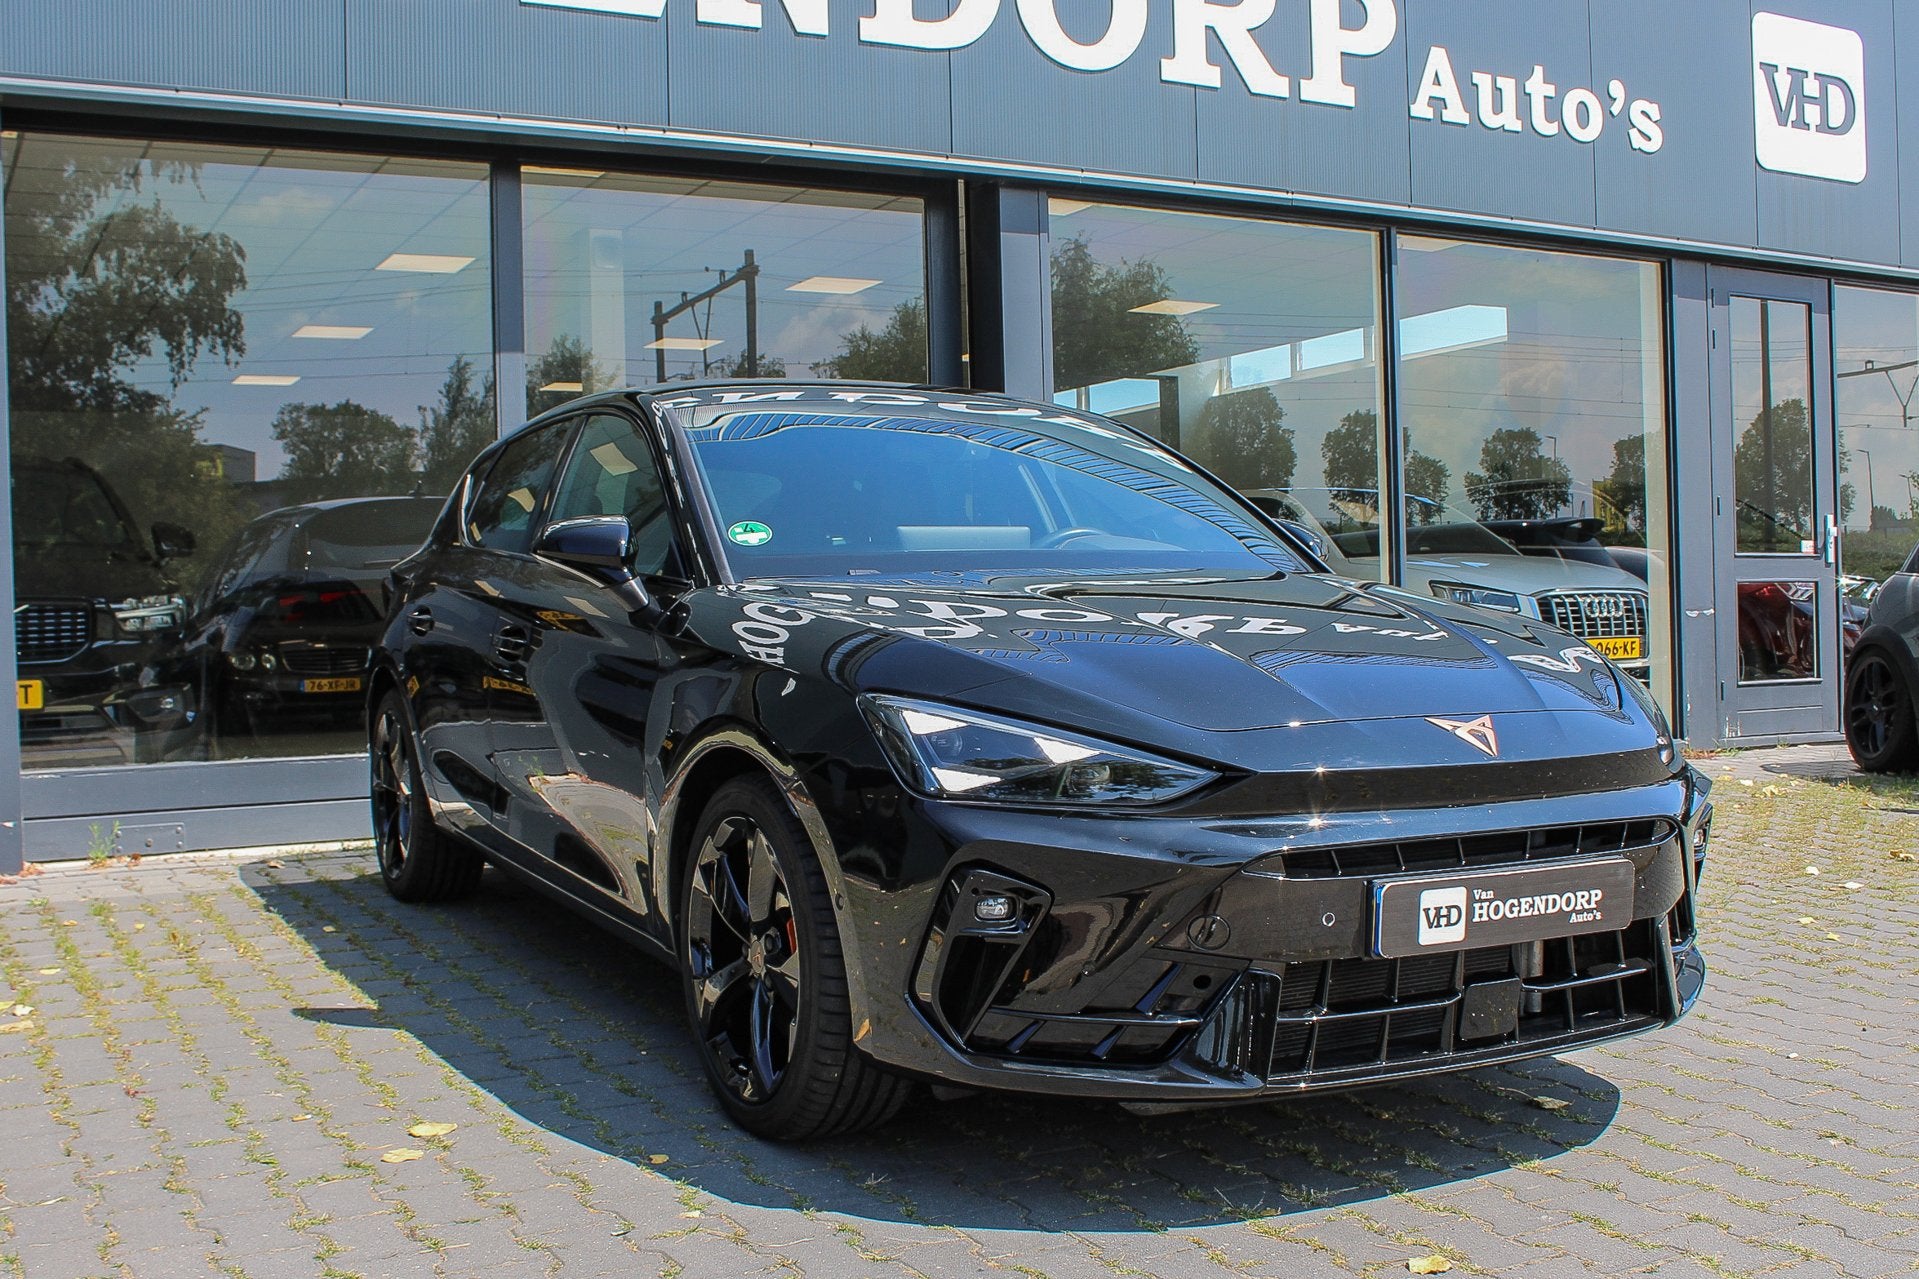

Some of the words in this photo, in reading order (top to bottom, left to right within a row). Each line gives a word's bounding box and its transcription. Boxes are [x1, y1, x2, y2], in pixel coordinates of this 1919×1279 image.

[519, 0, 1397, 108] ORP
[1409, 46, 1664, 153] Auto's
[1759, 62, 1856, 136] VHD
[1472, 889, 1603, 922] HOGENDORP
[1473, 889, 1494, 900] Van
[1423, 904, 1462, 929] VHD
[1569, 910, 1602, 923] Auto's
